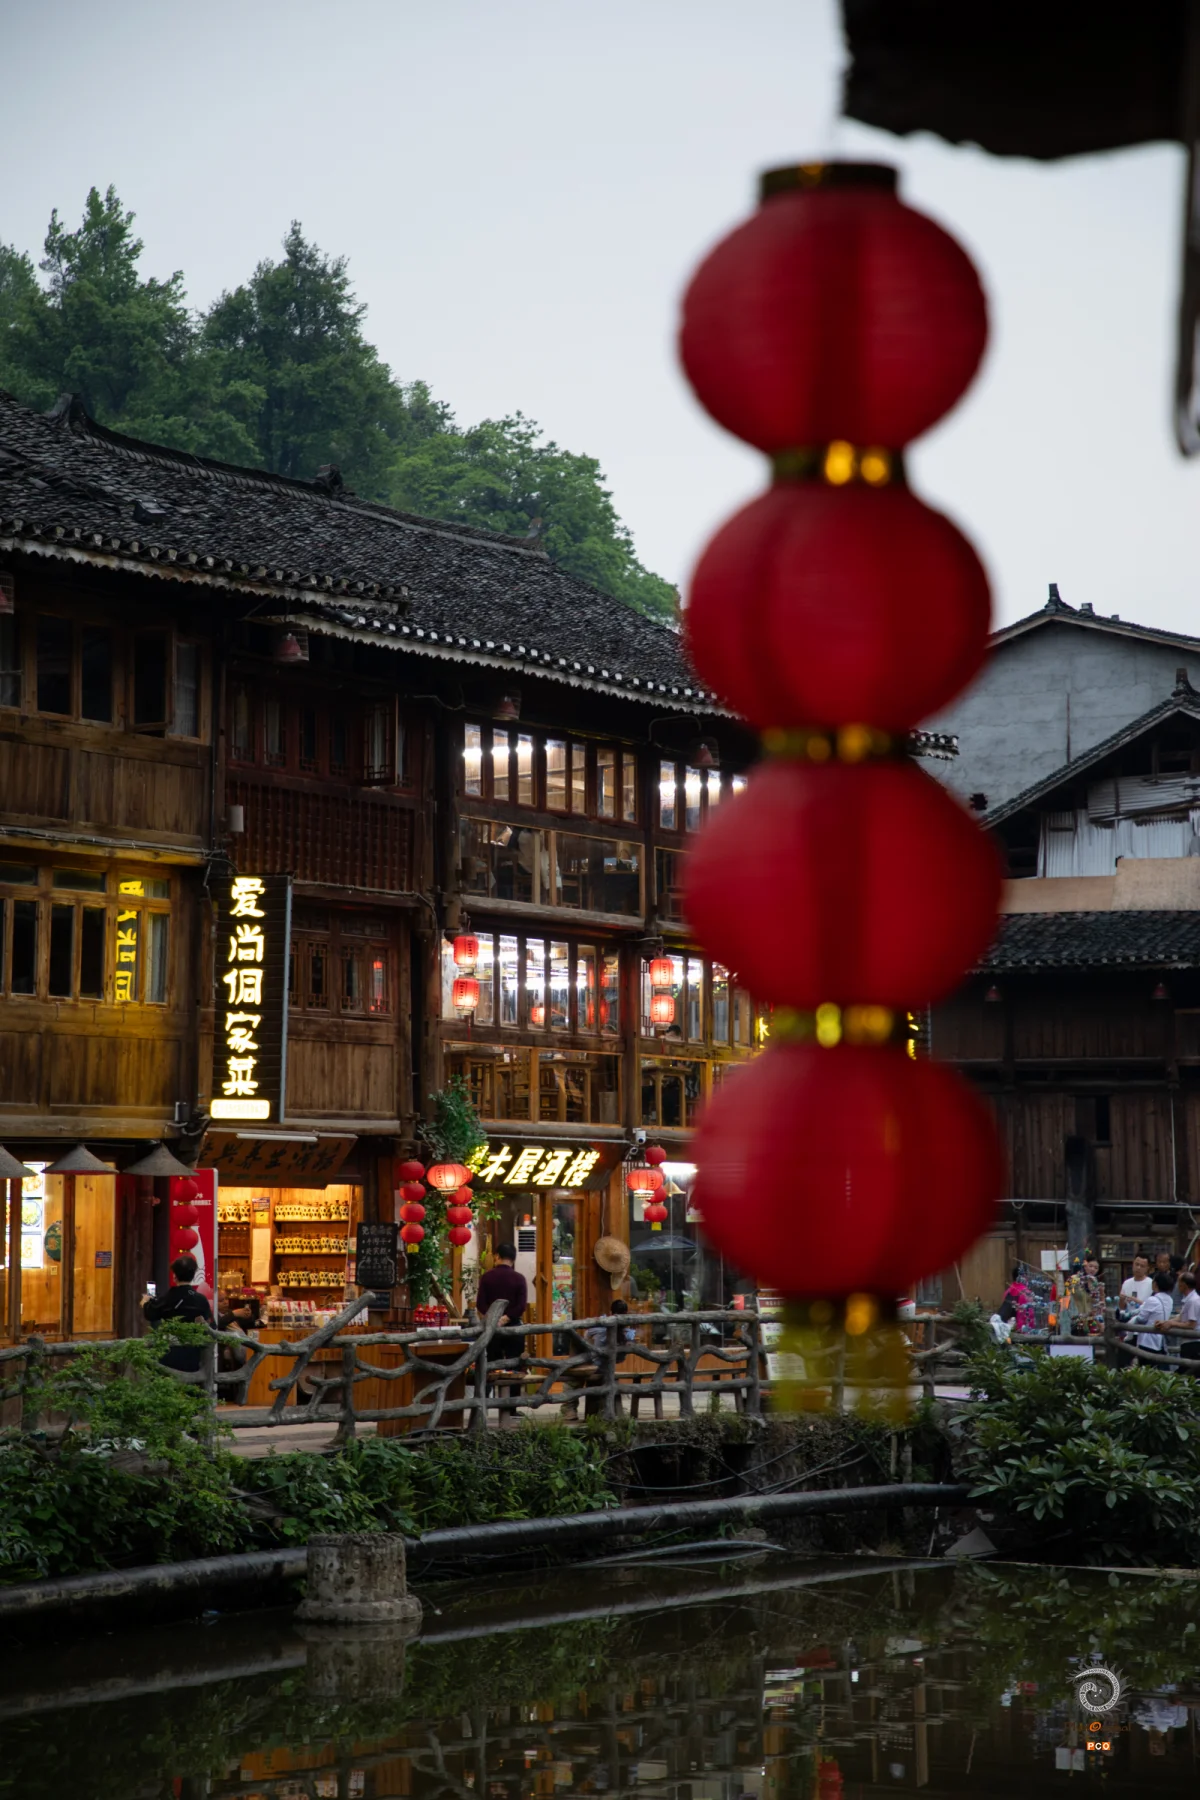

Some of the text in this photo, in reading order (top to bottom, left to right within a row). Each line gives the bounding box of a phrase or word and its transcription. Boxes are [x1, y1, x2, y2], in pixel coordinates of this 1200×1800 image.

[222, 877, 266, 1096] 爱尚侗家菜
[467, 1145, 600, 1187] 木屋酒楼
